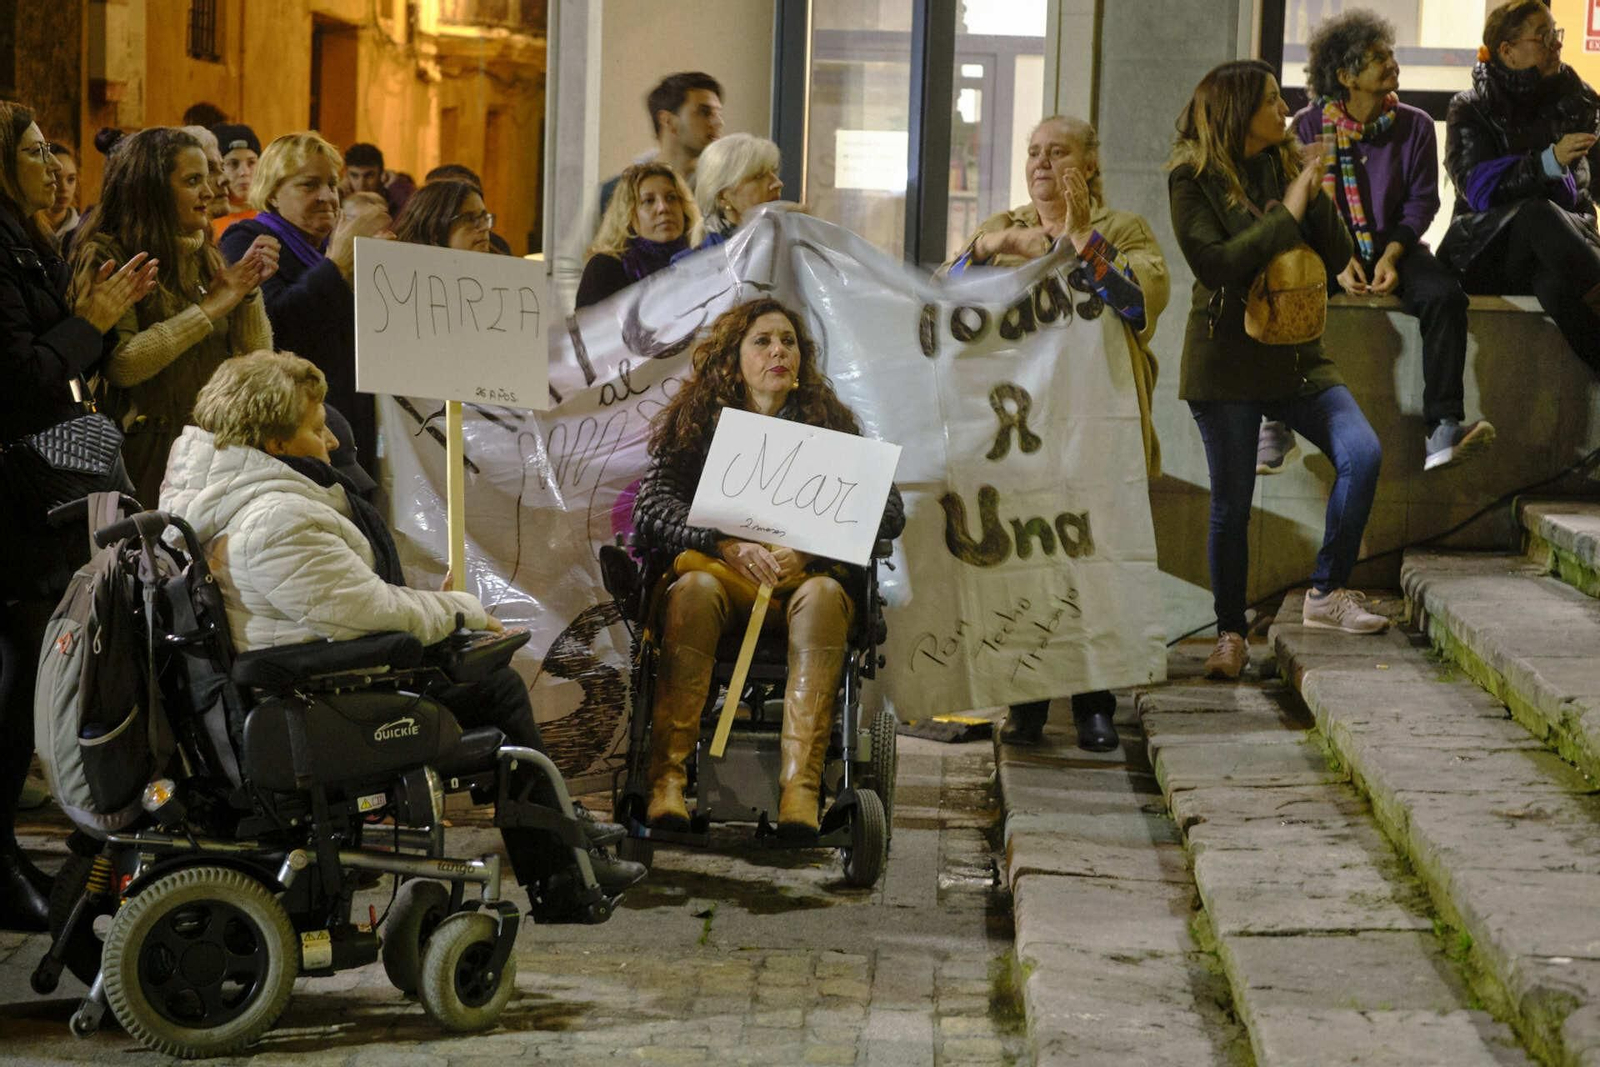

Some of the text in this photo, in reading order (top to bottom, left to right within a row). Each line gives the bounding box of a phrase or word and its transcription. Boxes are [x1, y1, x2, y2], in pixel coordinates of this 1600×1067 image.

[373, 263, 541, 340] MARIA
[721, 433, 859, 524] Mar
[938, 484, 1096, 569] Una
[910, 618, 972, 673] Pan
[374, 724, 420, 741] QUICKIE
